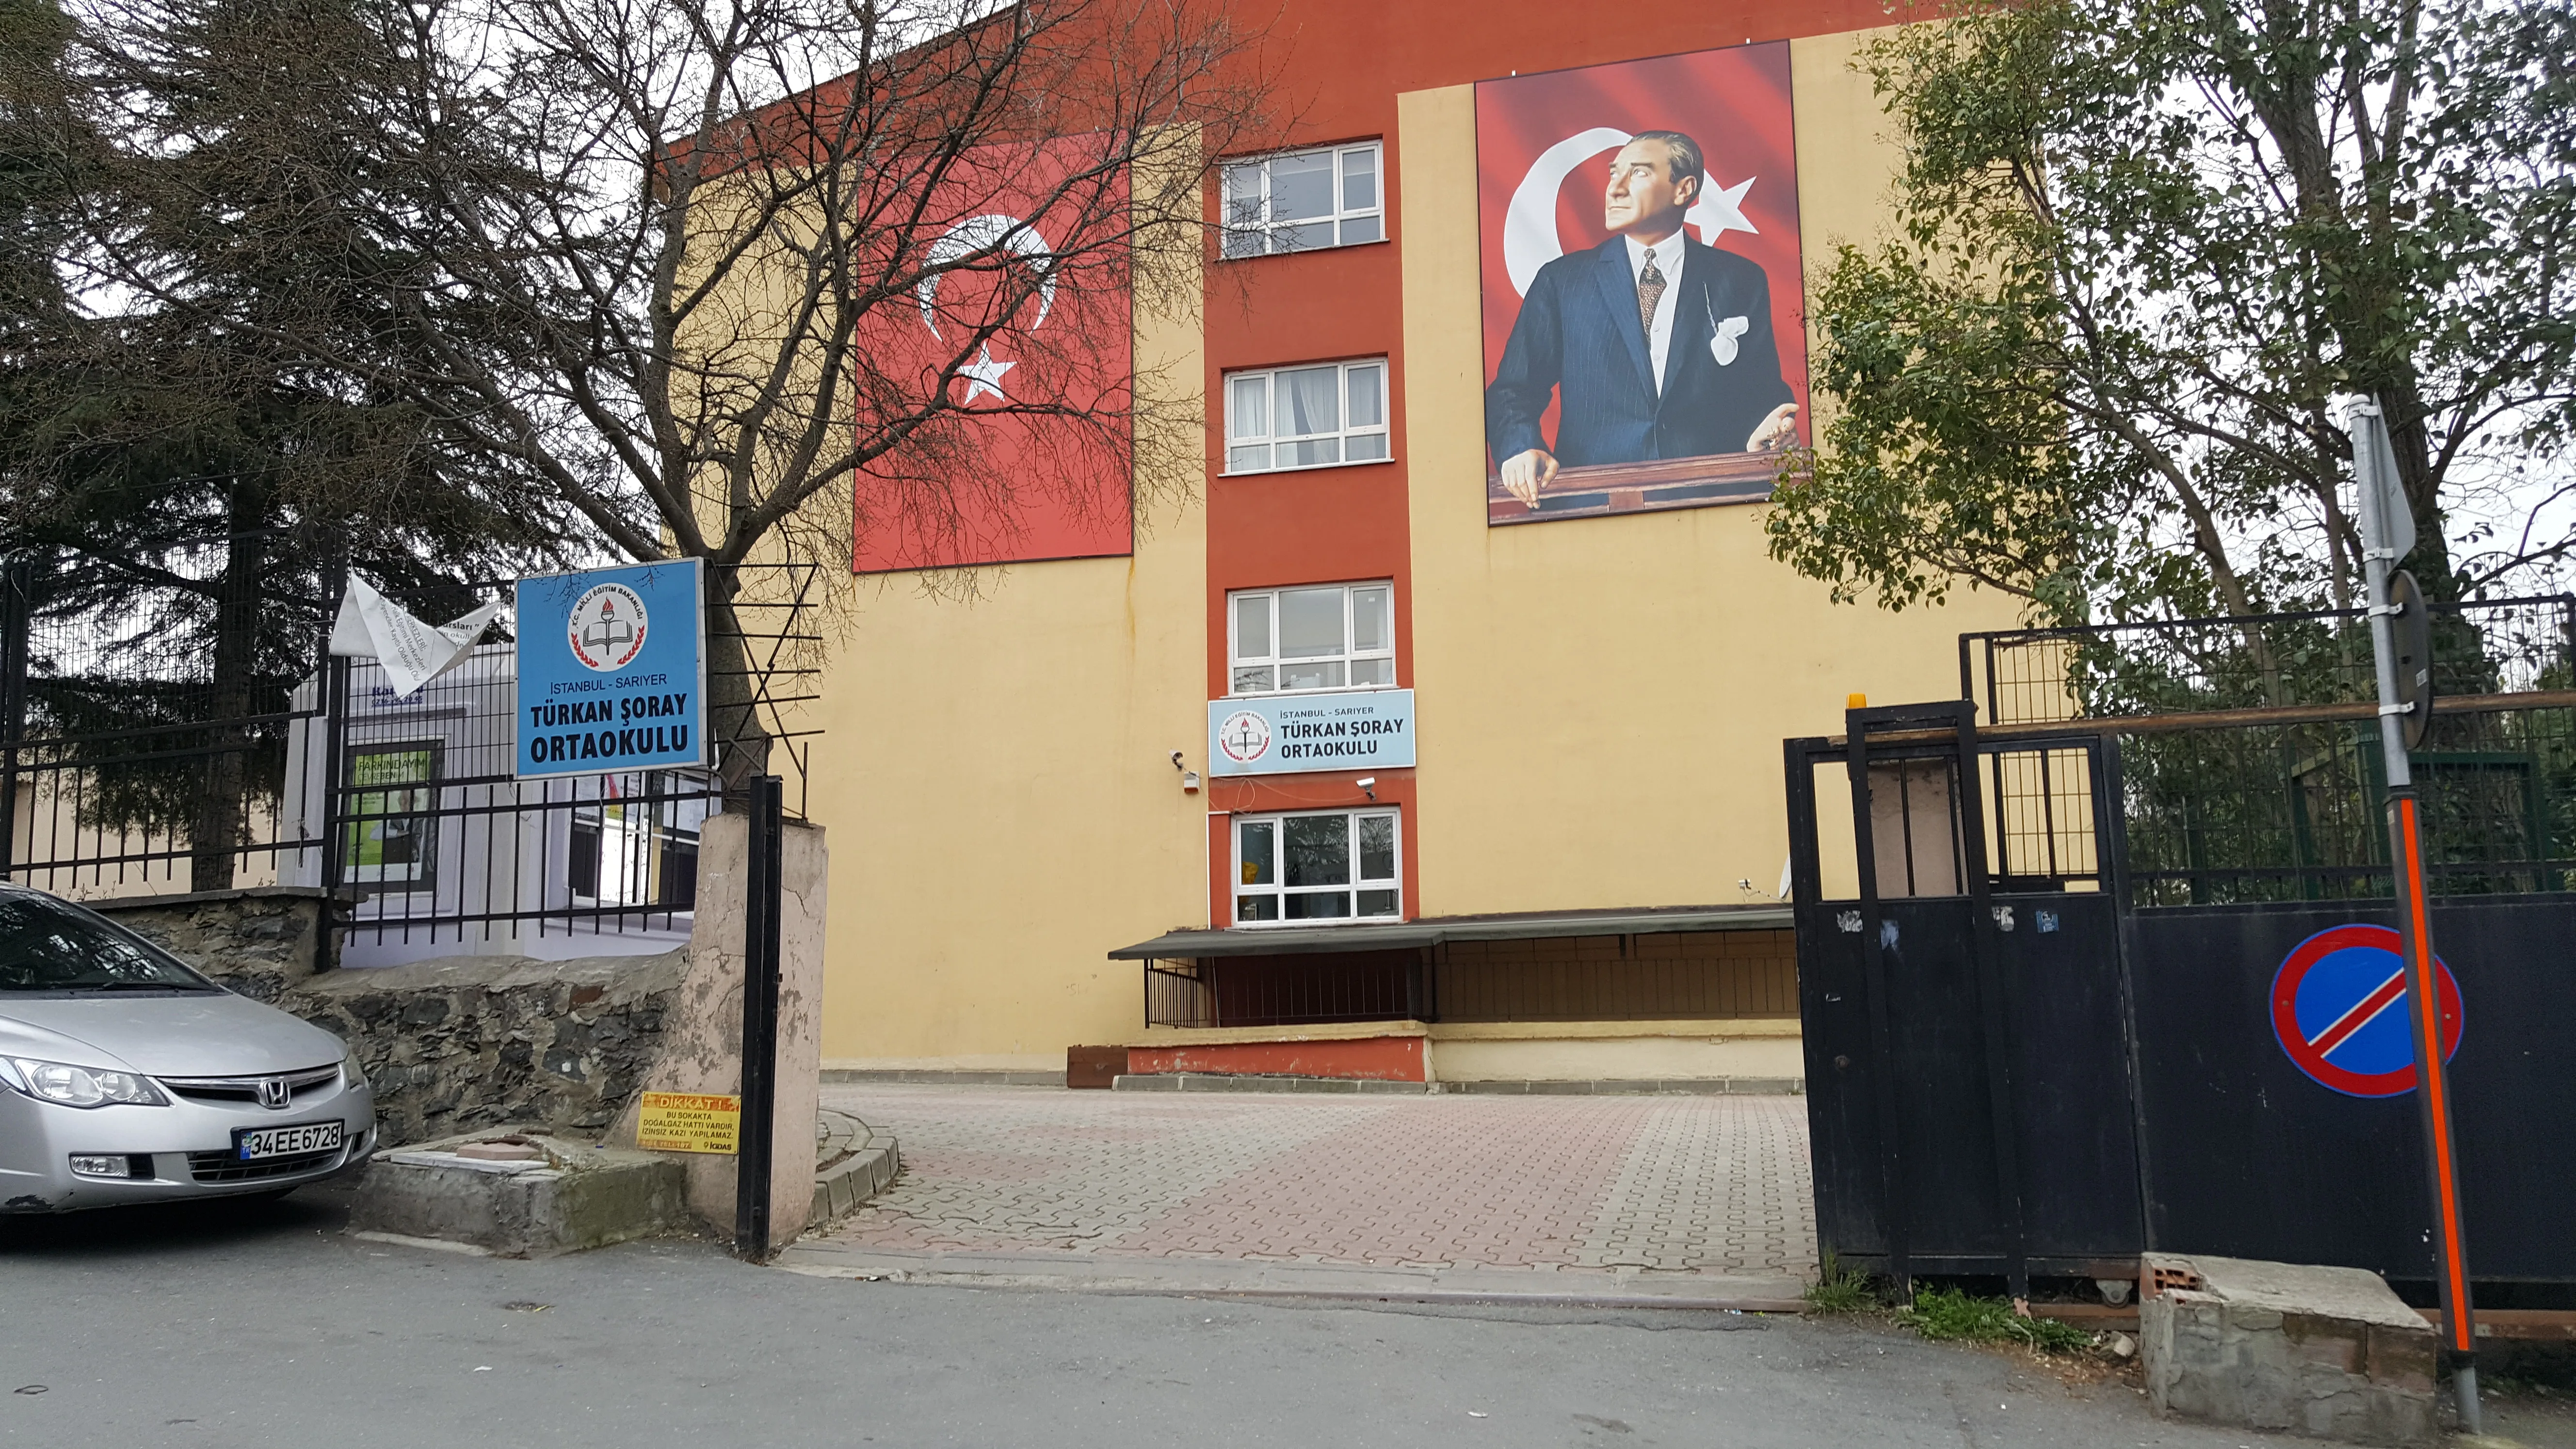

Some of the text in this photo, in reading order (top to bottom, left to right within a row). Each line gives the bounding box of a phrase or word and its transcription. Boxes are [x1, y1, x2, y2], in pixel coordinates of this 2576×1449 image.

[593, 585, 616, 596] EĞİTİM
[618, 588, 644, 620] BAKANLIĞI
[398, 646, 414, 671] Olduğu
[405, 638, 427, 671] Merkezleri
[550, 681, 606, 695] İSTANBUL
[615, 674, 667, 689] SARIYER
[531, 693, 687, 727] TÜRKAN ŞORAY
[1280, 709, 1326, 719] İSTANBUL
[1335, 707, 1374, 716] SARIYER
[1251, 713, 1269, 732] BAKANLIĞI
[1281, 719, 1403, 740] TÜRKAN ŞORAY
[531, 724, 688, 763] ORTAOKULU
[1281, 740, 1378, 758] ORTAOKULU
[644, 1119, 681, 1127] DOĞALGAZ
[678, 1112, 712, 1120] SOKAKTA
[642, 1127, 666, 1136] İZİNSİZ
